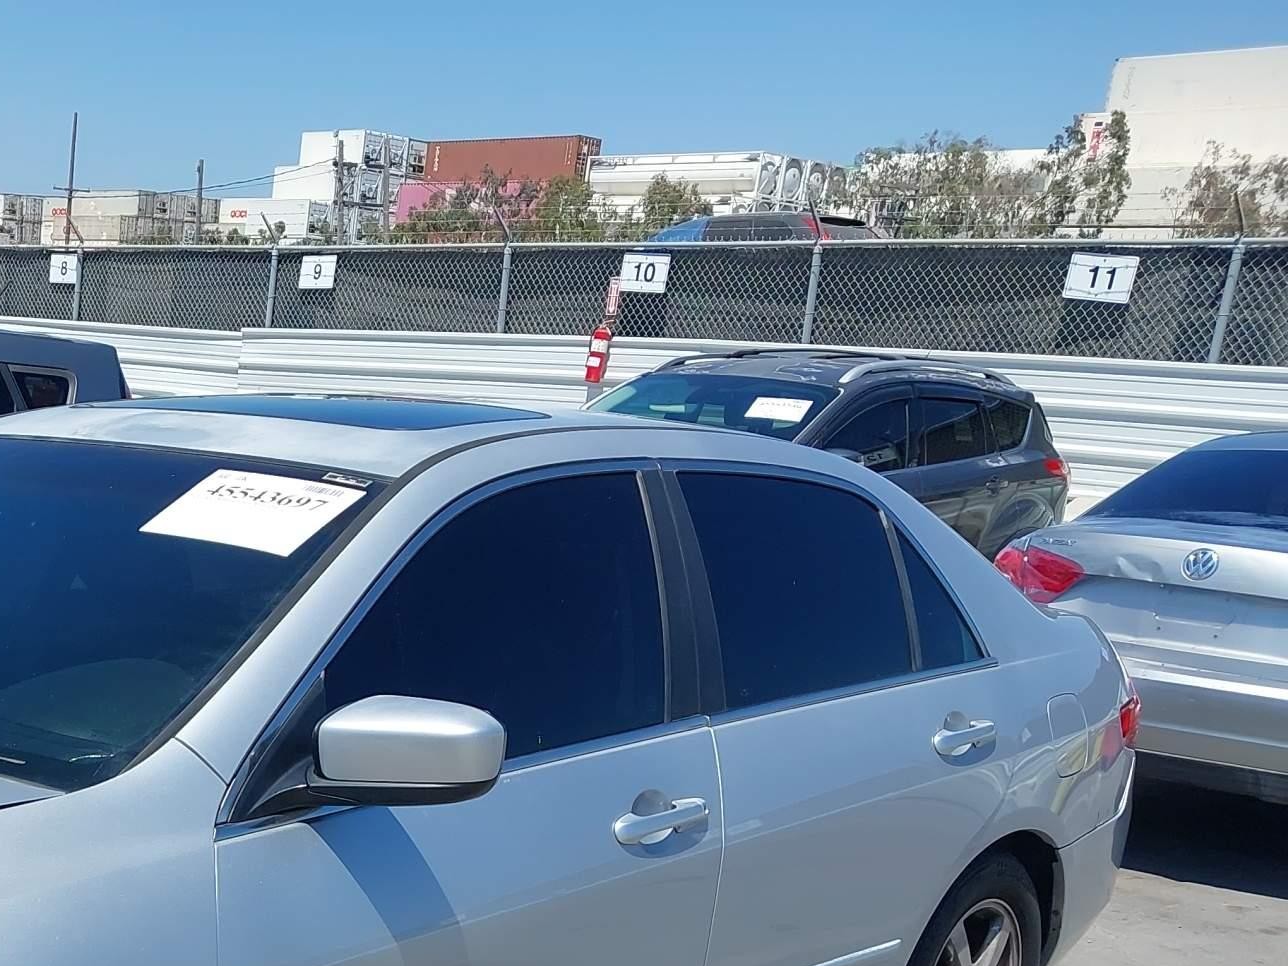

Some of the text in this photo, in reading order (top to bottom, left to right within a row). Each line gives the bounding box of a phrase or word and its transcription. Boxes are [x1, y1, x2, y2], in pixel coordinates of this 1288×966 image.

[60, 260, 68, 276] 8
[313, 263, 322, 280] 9
[633, 262, 656, 283] 10
[1088, 265, 1117, 290] 11
[207, 483, 330, 512] 45543697
